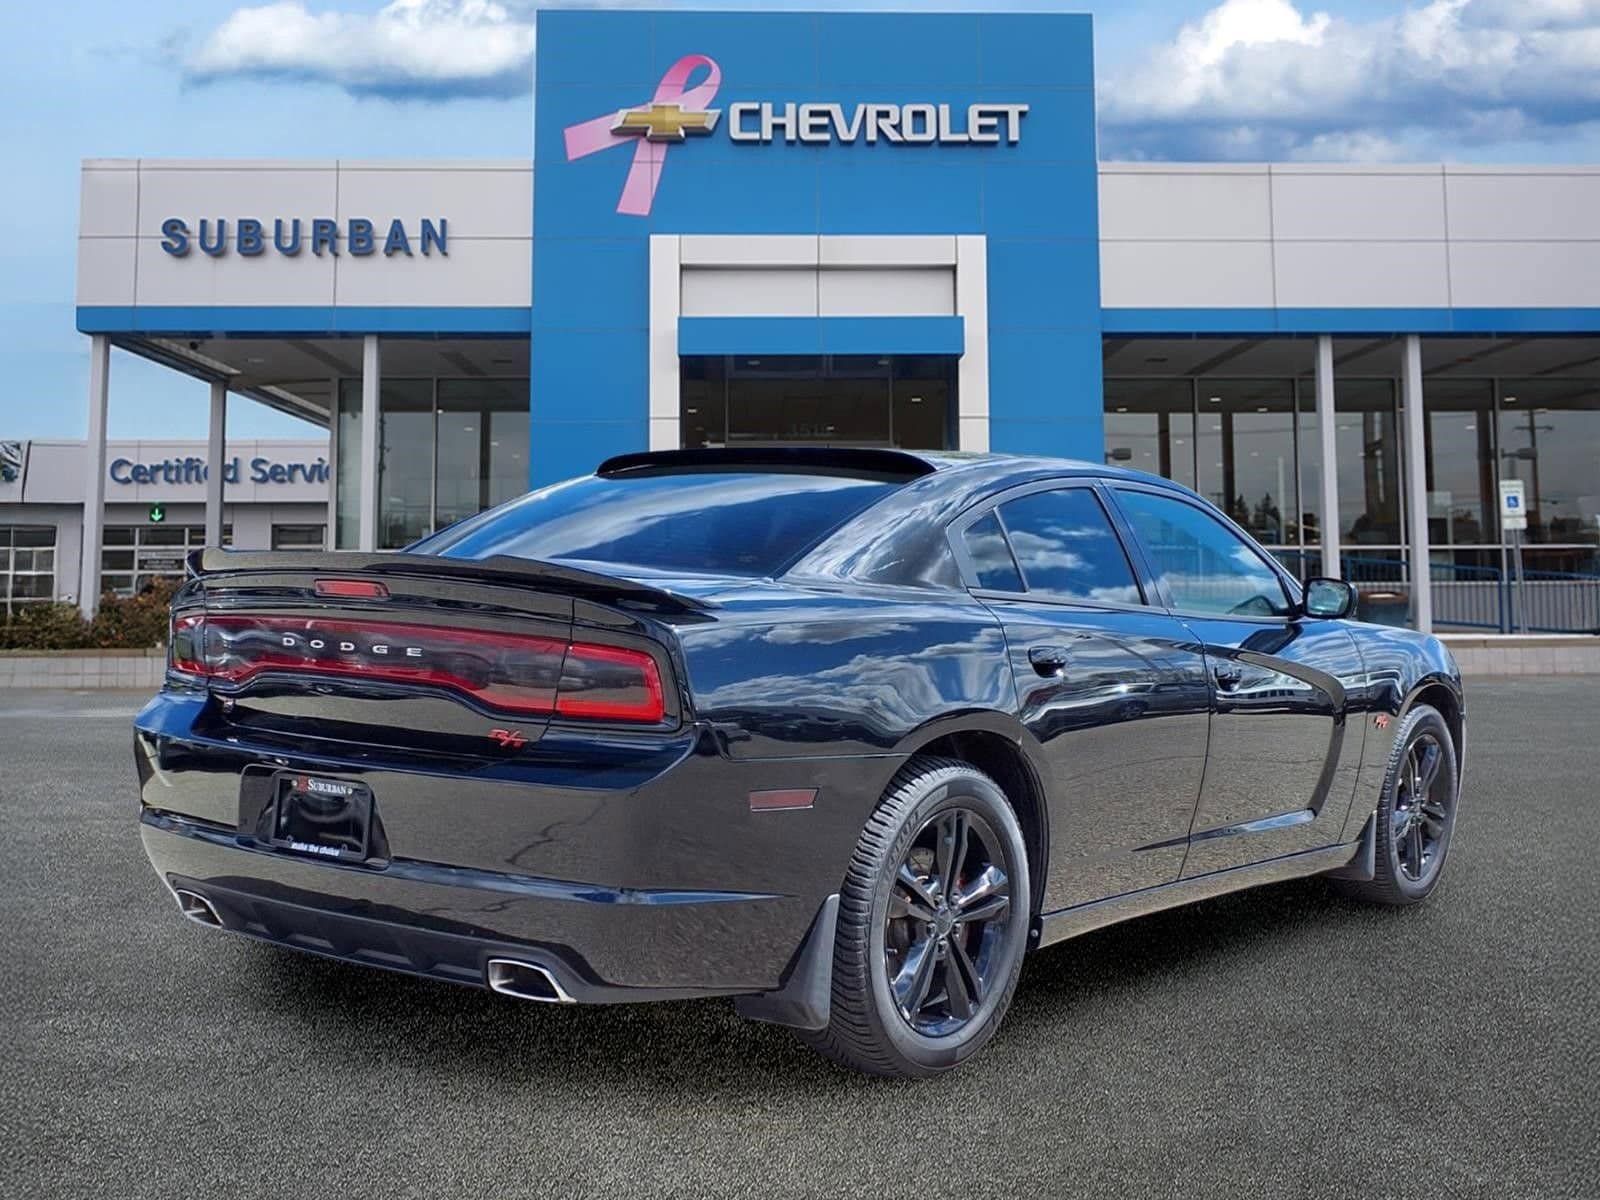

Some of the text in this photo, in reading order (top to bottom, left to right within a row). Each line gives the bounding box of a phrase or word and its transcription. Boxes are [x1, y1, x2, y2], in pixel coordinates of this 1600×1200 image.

[729, 101, 1029, 145] CHEVROLET
[160, 217, 449, 257] SUBURBAN
[110, 457, 240, 484] Certifid
[282, 636, 423, 657] DODGE
